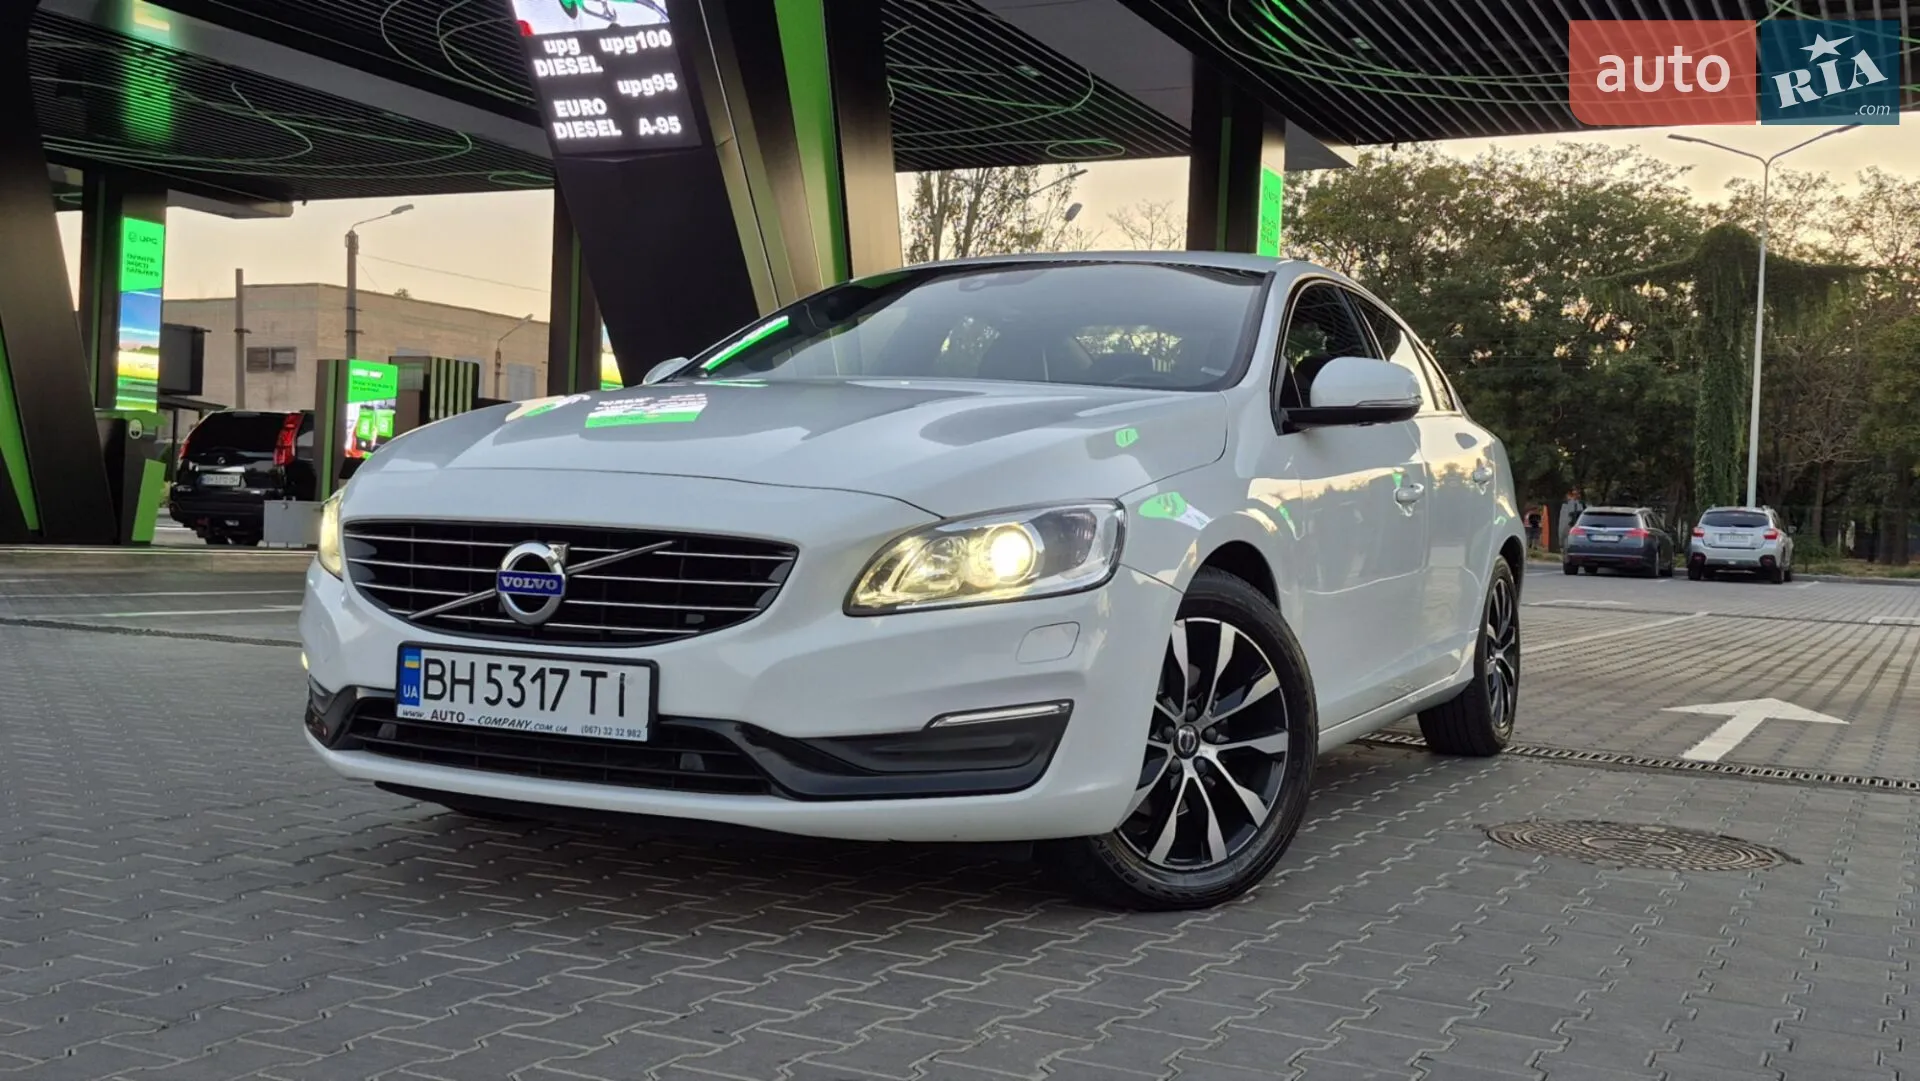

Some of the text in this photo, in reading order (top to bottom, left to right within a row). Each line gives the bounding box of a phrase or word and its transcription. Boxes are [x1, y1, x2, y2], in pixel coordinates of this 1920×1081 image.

[543, 37, 581, 57] upg
[599, 29, 673, 56] upg100
[533, 55, 604, 78] DIESEL
[616, 72, 679, 97] upg95
[553, 99, 608, 118] EURO
[552, 118, 623, 140] DIESEL
[638, 116, 683, 136] A-95
[500, 576, 559, 590] VOLVO
[403, 684, 419, 699] UA
[422, 658, 476, 704] BH
[483, 663, 570, 712] 5317
[431, 709, 465, 723] AUTO
